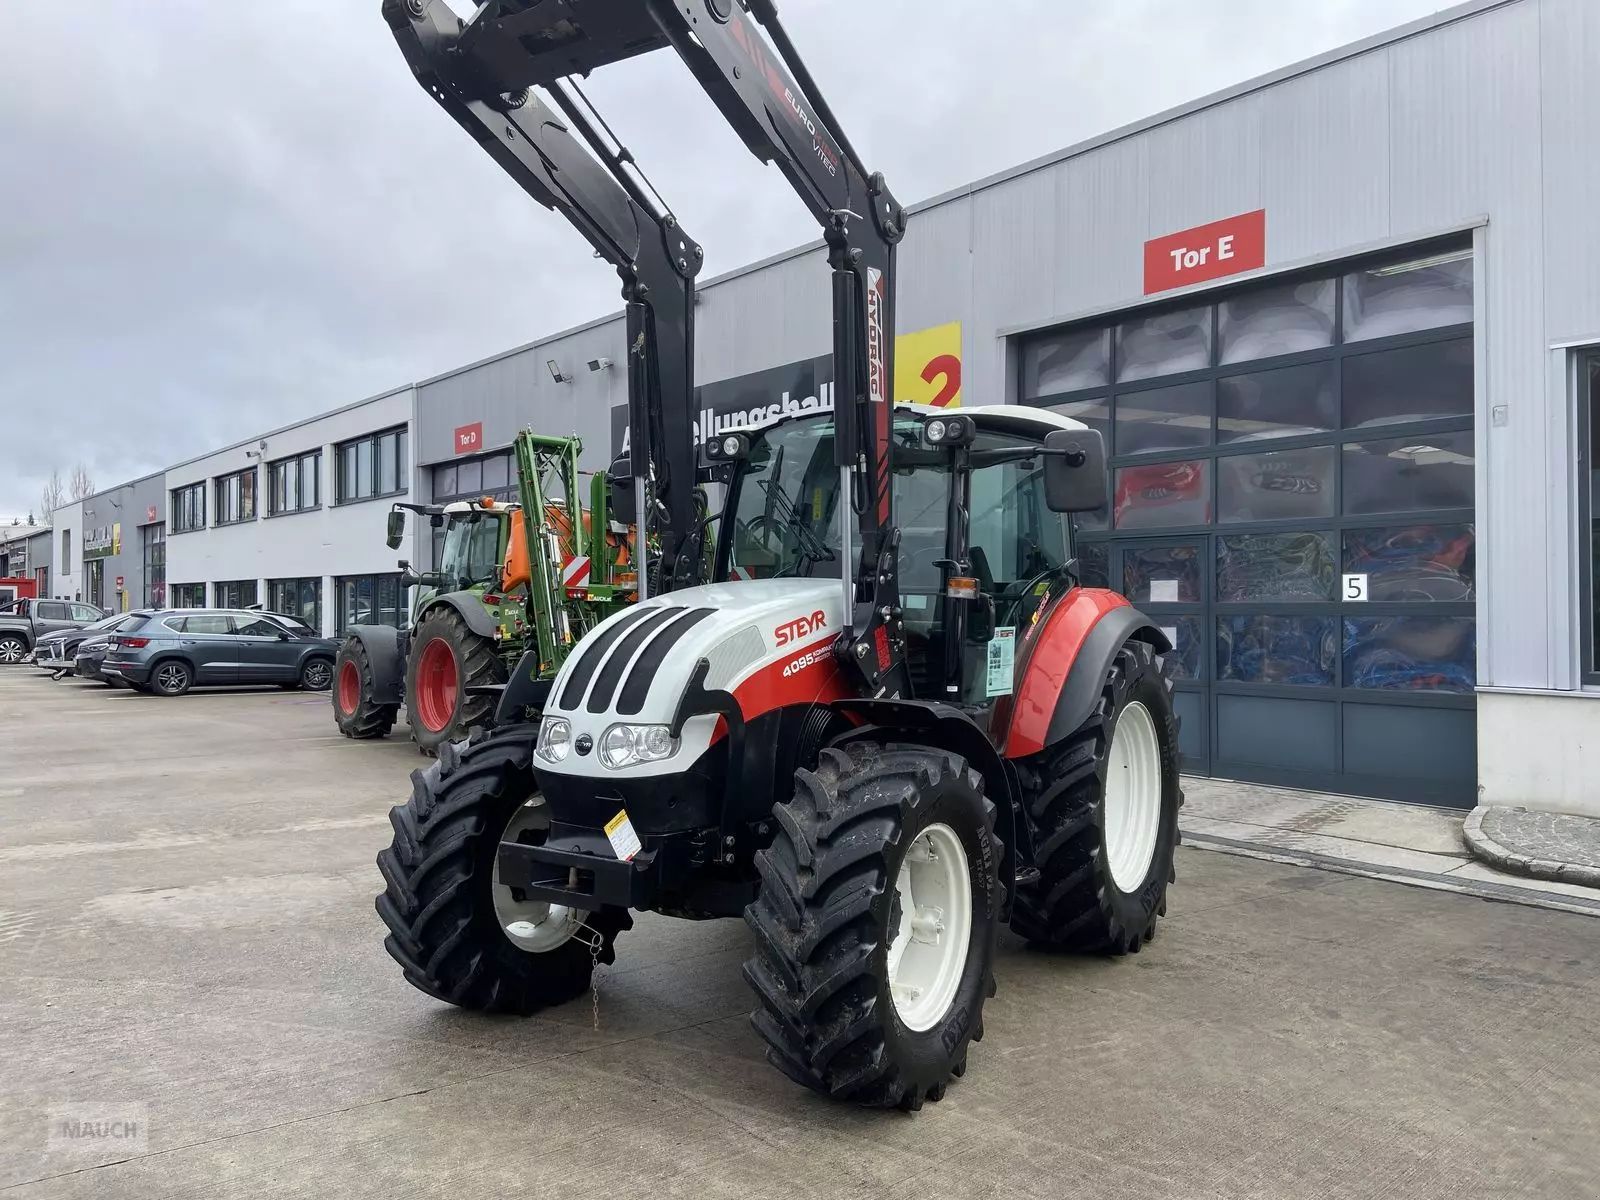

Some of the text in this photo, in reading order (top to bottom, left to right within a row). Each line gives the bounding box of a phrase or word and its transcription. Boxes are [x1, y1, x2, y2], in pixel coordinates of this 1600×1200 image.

[1170, 235, 1234, 271] Tor E
[868, 288, 879, 395] HYDRAC
[920, 354, 962, 407] 2
[460, 431, 476, 446] Tor D
[1347, 577, 1361, 599] 5
[774, 609, 827, 648] STEYR
[782, 652, 814, 678] 4095
